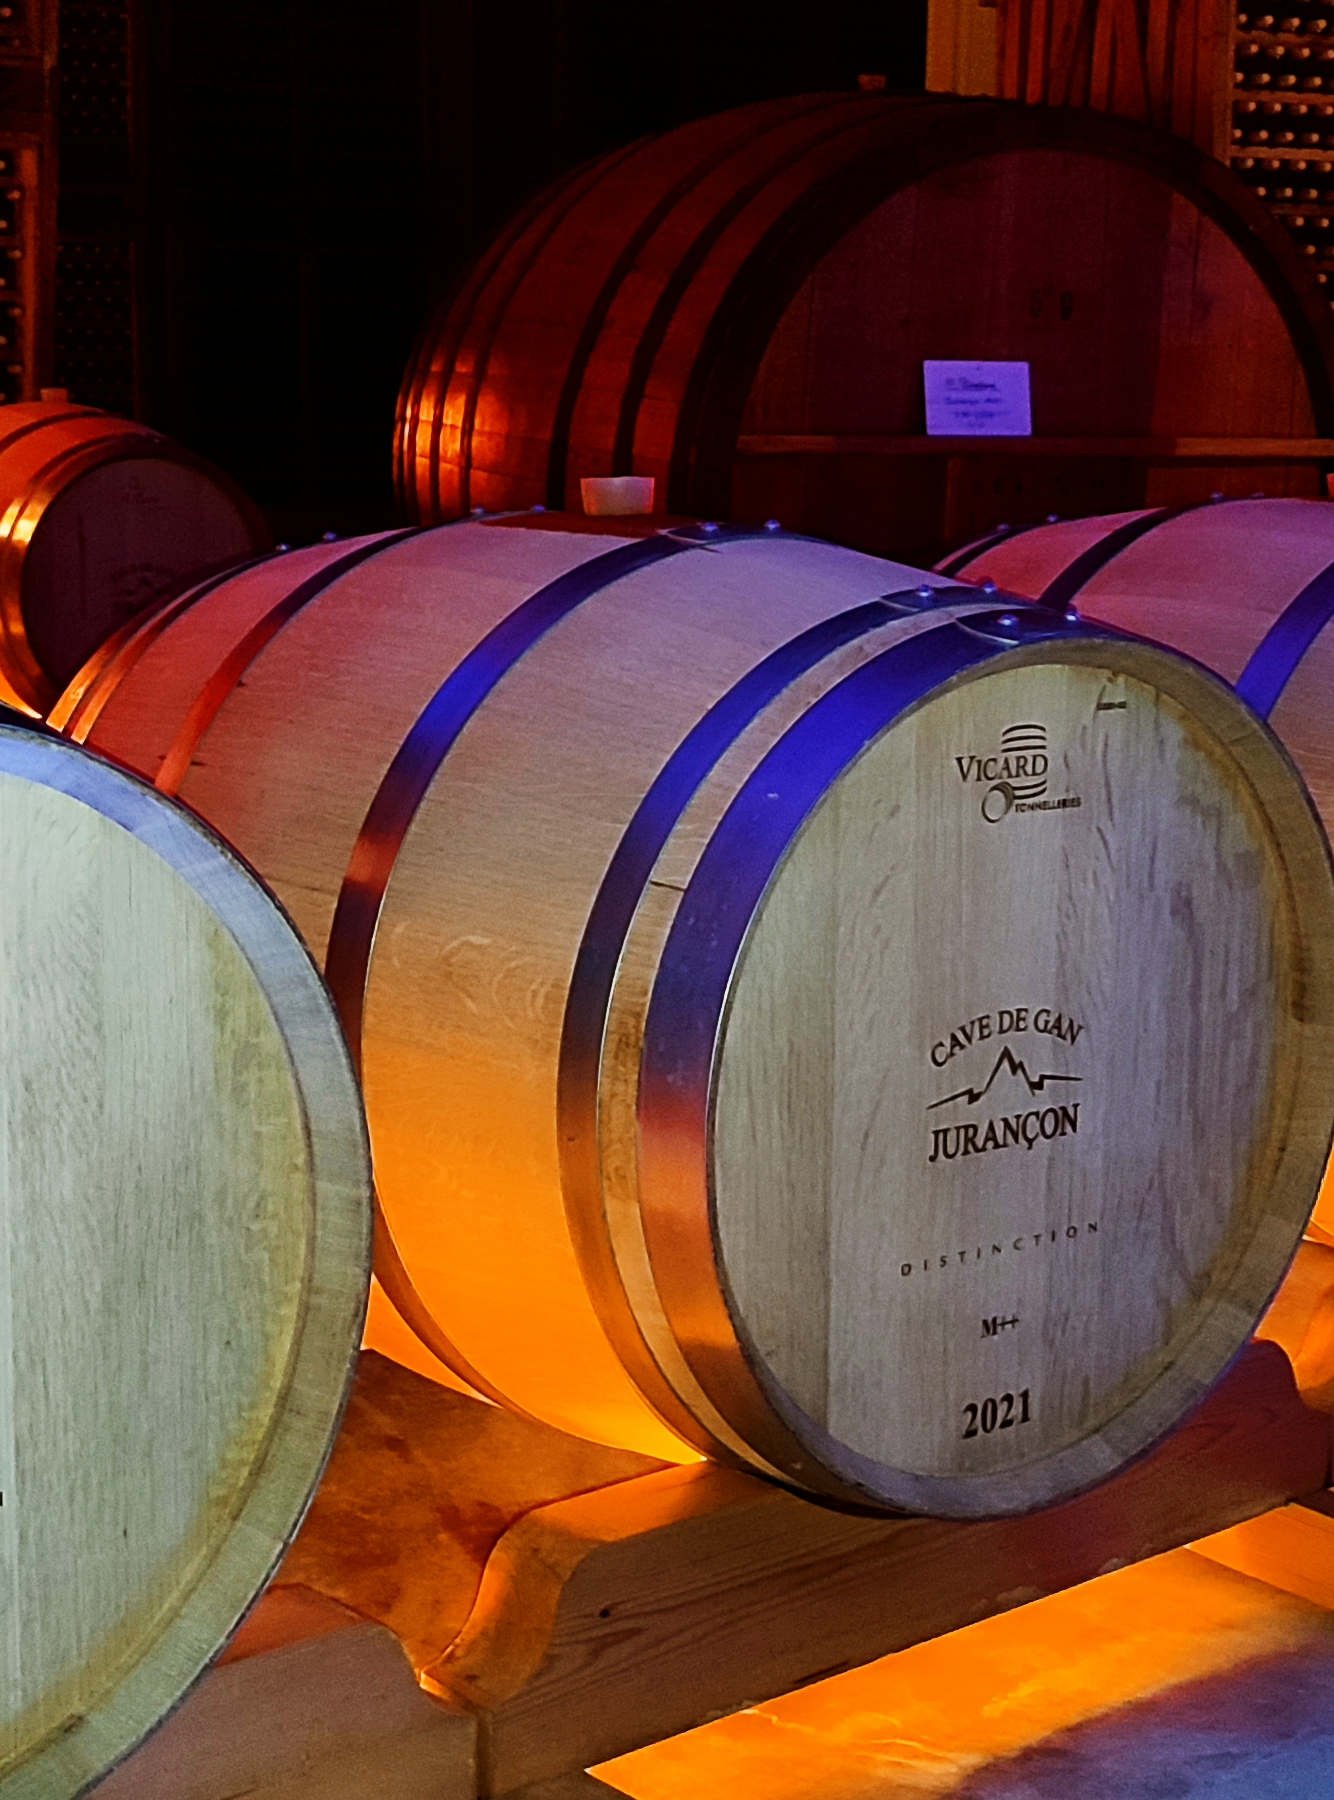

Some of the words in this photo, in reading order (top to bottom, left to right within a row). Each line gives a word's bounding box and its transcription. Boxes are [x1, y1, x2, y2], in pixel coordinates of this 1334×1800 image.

[955, 754, 1049, 782] VICARD
[1014, 797, 1082, 813] TONNELLERIES
[930, 1014, 993, 1068] CAVE
[997, 1007, 1030, 1035] DE
[1033, 1008, 1085, 1046] GAN
[928, 1102, 1081, 1163] JURANÇON
[900, 1221, 1099, 1277] DISTINCTION
[980, 1314, 1020, 1339] M++
[961, 1387, 1031, 1440] 2021
